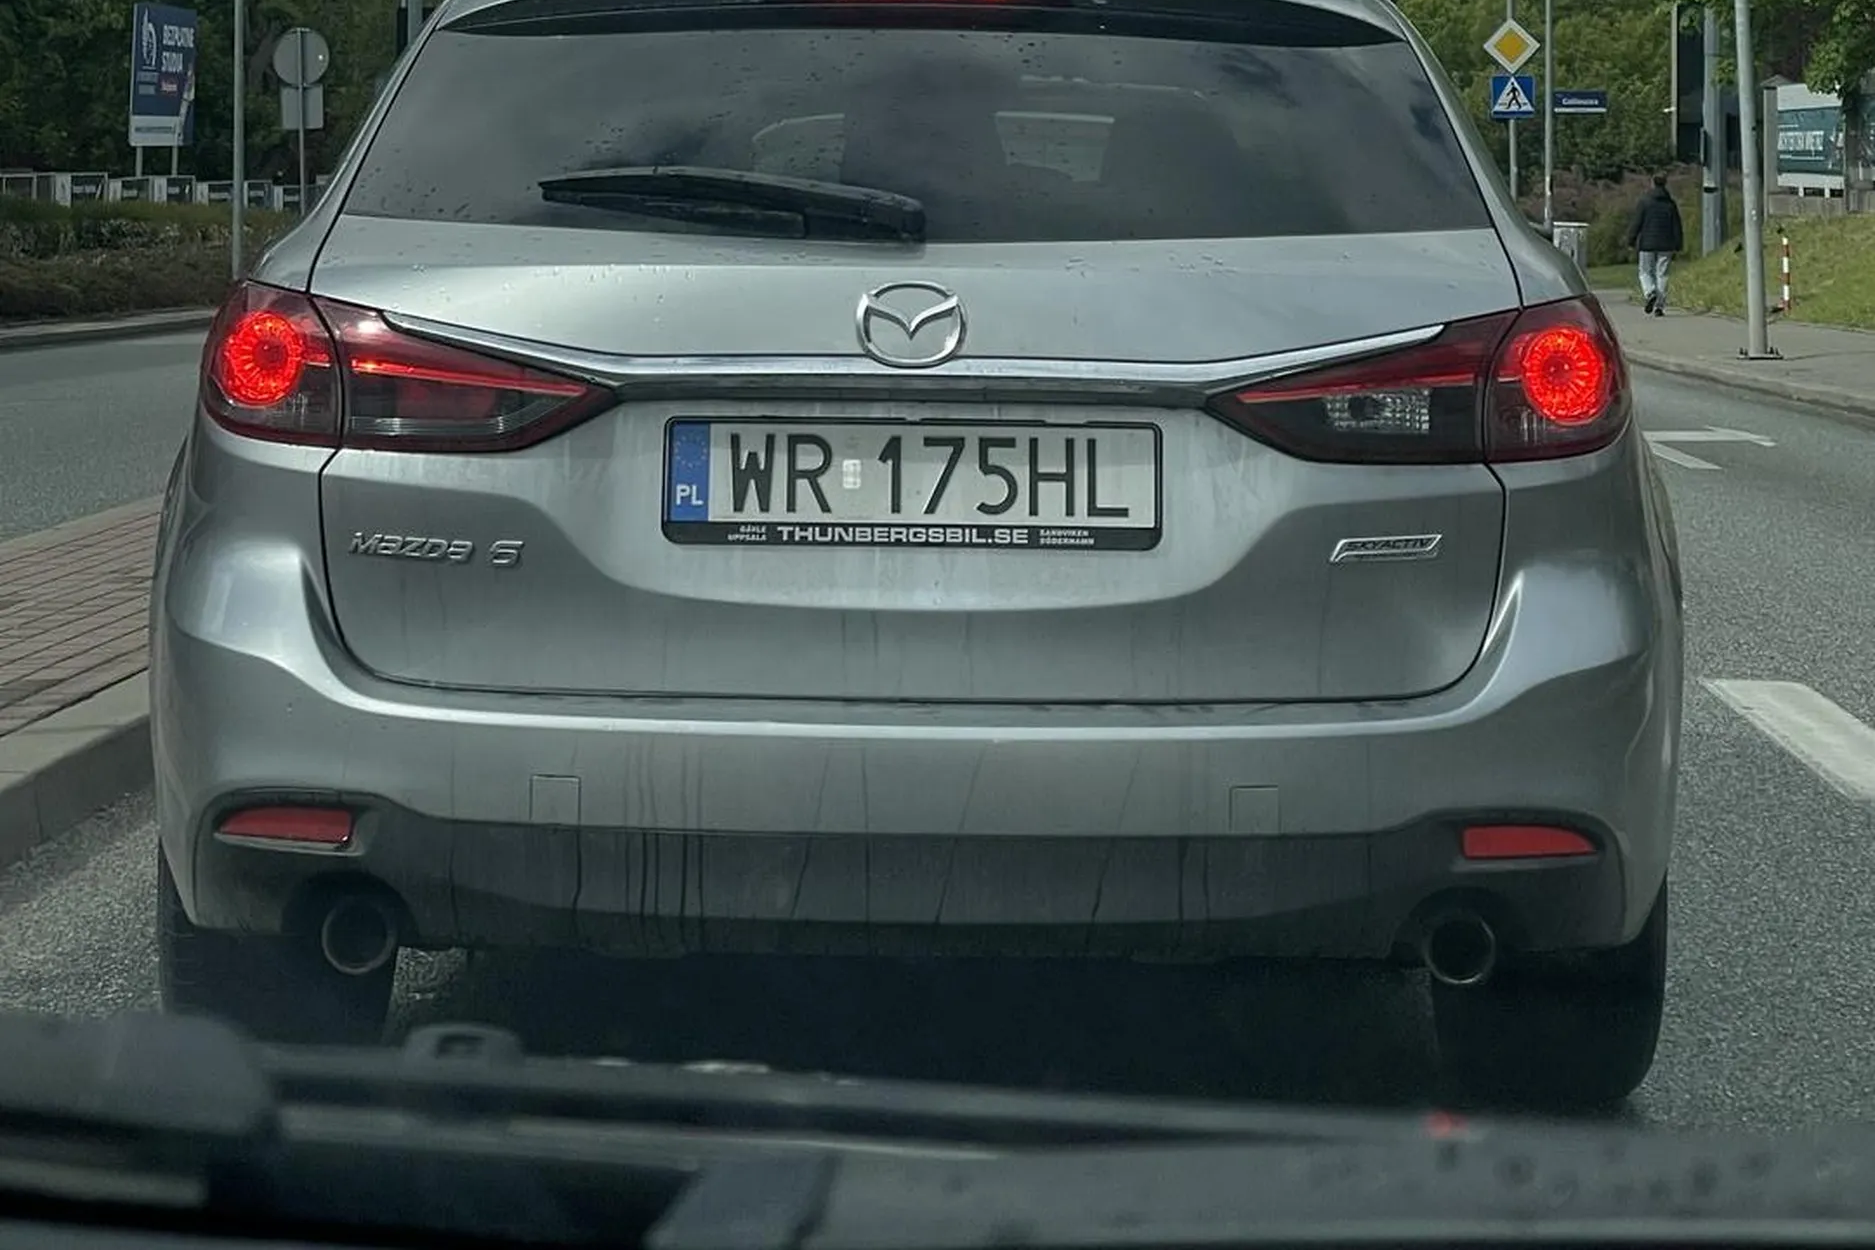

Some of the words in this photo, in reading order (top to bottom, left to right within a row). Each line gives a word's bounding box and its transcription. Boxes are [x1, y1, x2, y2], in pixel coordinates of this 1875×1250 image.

[730, 433, 833, 514] WR
[878, 435, 1130, 518] 175HL
[675, 484, 704, 506] PL
[777, 526, 1029, 544] THUNBERGSBIL.SE
[490, 540, 525, 566] 6
